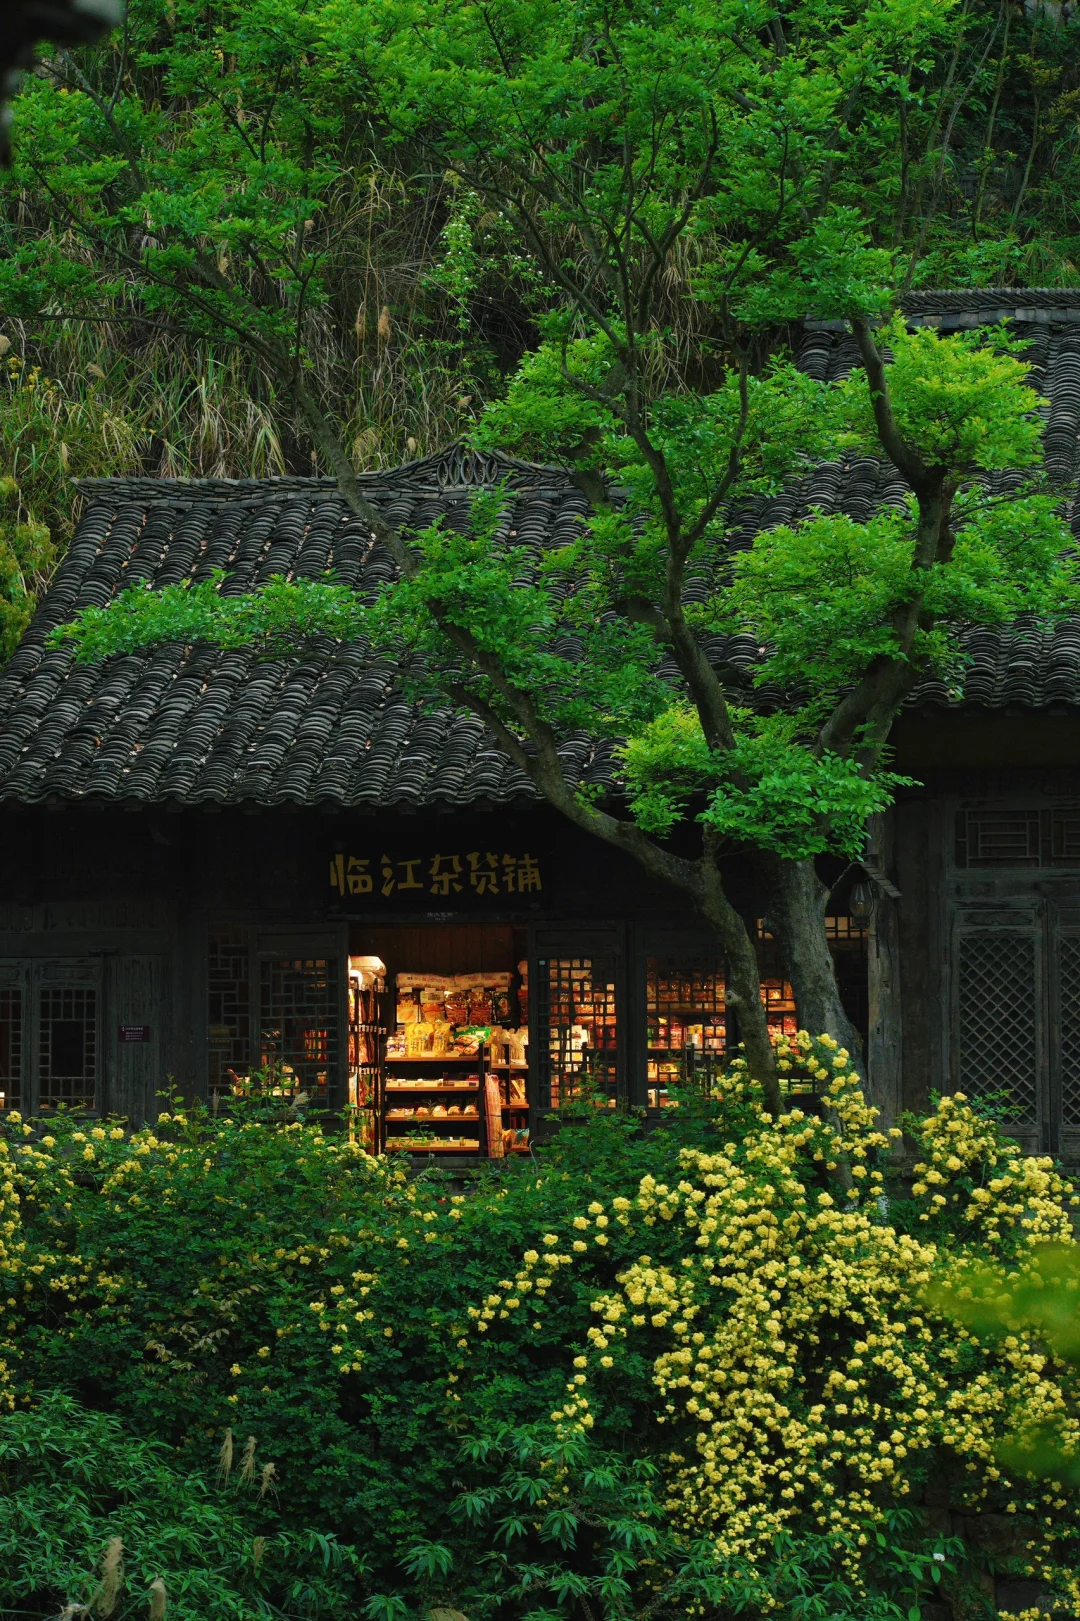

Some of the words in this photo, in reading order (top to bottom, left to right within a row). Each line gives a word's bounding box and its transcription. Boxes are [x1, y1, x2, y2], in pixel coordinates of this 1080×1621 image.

[329, 851, 543, 897] 临江杂货铺
